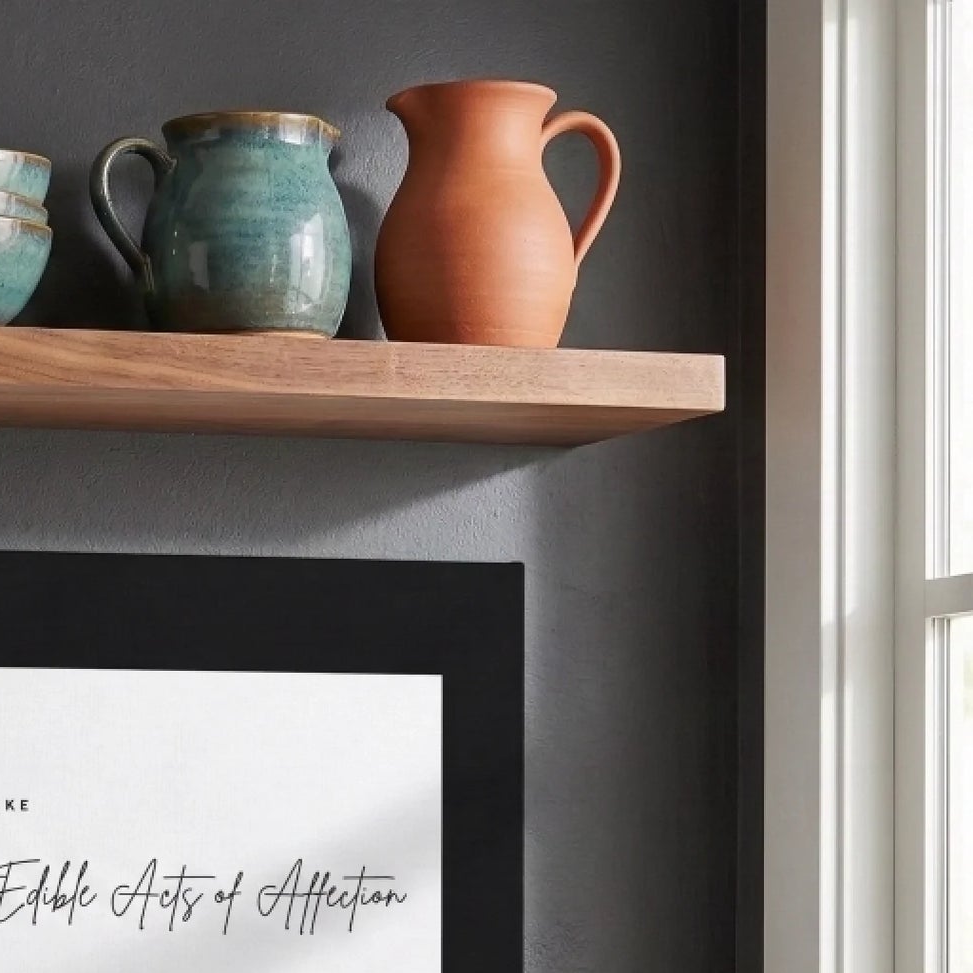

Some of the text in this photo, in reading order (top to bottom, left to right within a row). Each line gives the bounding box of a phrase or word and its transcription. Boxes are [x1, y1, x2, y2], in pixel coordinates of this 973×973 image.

[111, 858, 217, 932] Acts
[214, 871, 244, 936] of
[257, 857, 409, 936] Affection
